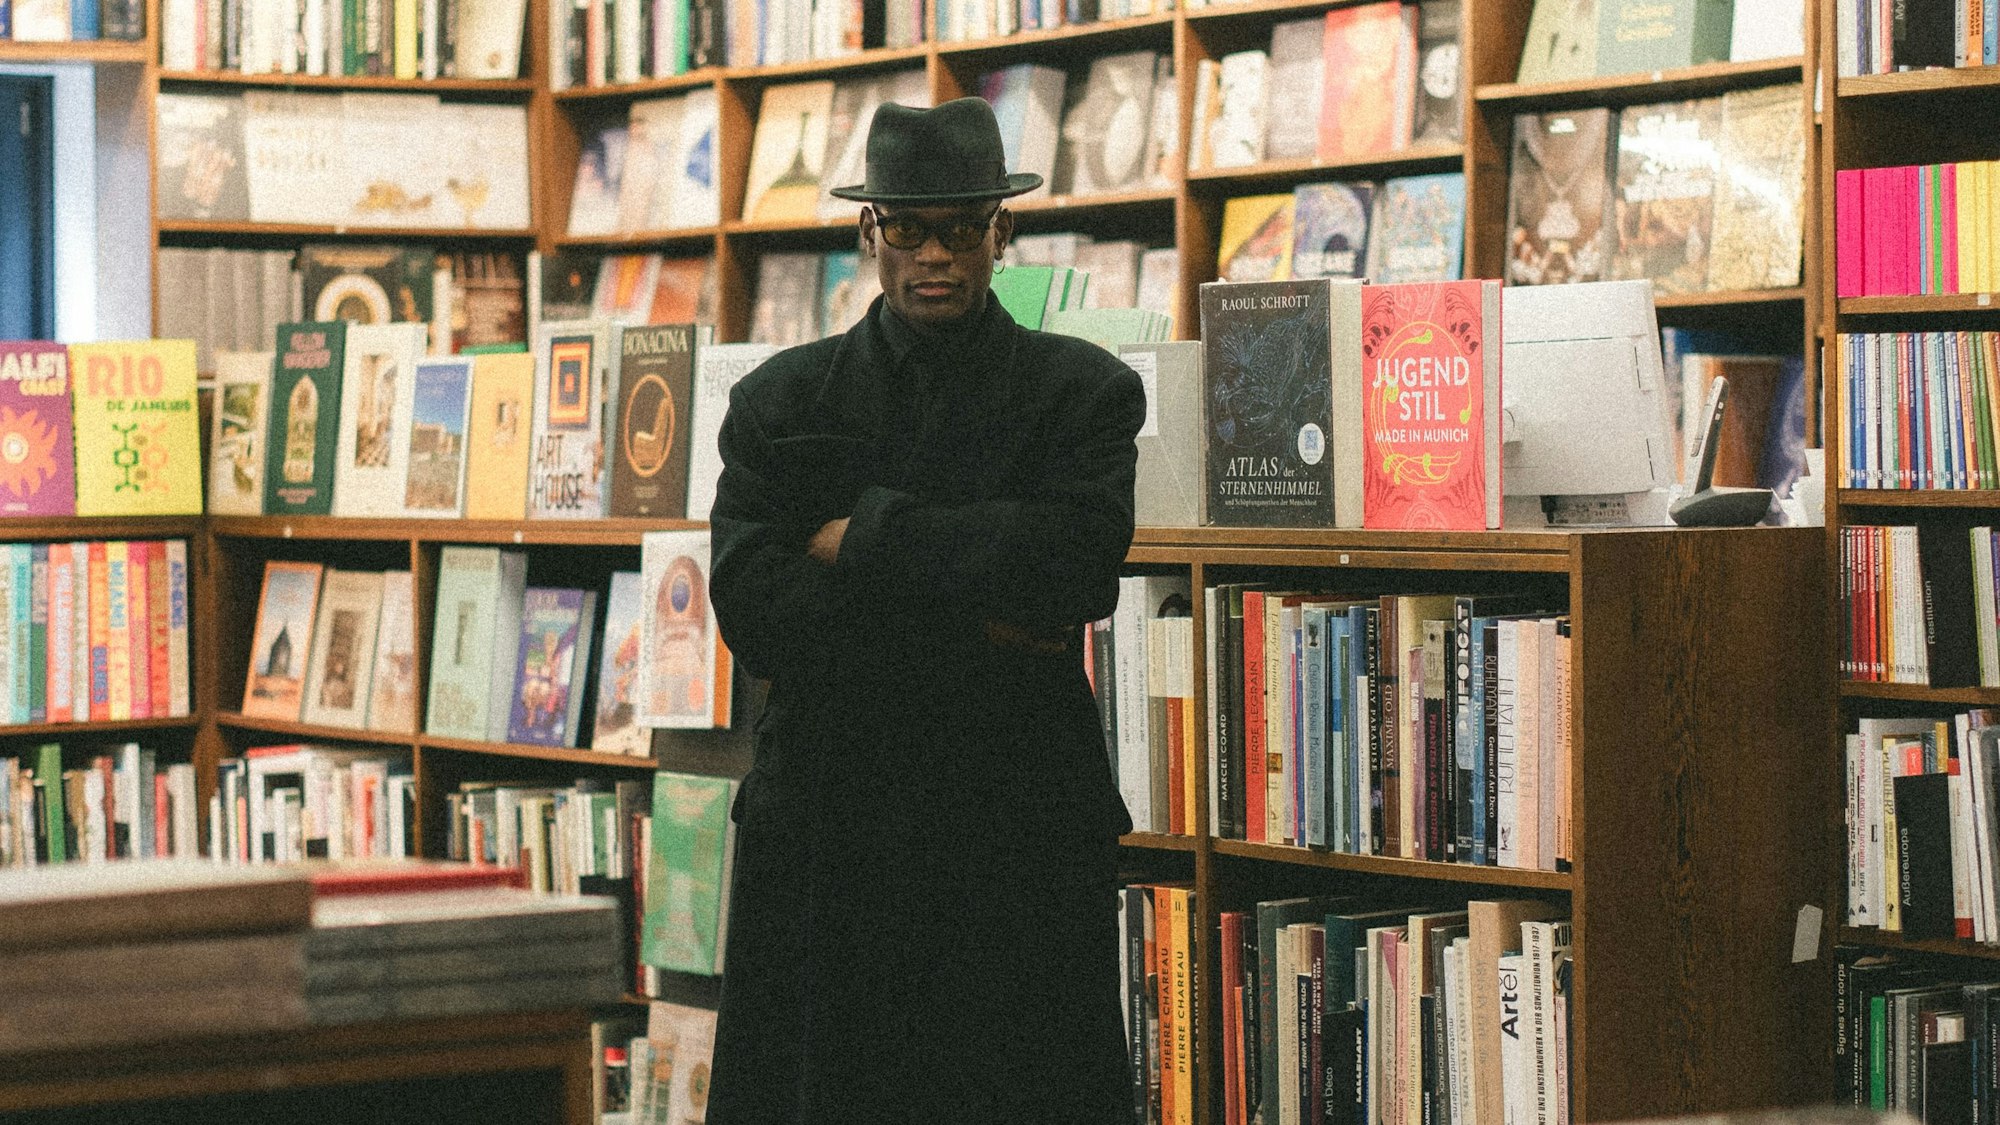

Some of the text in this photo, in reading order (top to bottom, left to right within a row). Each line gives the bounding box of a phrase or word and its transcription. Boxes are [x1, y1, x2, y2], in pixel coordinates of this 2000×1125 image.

[1222, 294, 1310, 312] RAOUL SCHROTT
[623, 328, 688, 356] BONACINA
[87, 354, 164, 397] RIO
[1373, 356, 1470, 387] JUGEND
[1399, 391, 1446, 421] STIL
[537, 434, 564, 467] ART
[1375, 427, 1469, 443] MADE IN MUNICH
[1226, 456, 1295, 477] ATLAS der
[534, 472, 584, 510] HOUSE
[1220, 481, 1322, 496] STERNENHIMMEL
[1925, 580, 1936, 644] Restitution
[1473, 642, 1482, 671] Paul
[1485, 654, 1498, 727] RUHLMANN
[1250, 660, 1260, 774] PIERRE LEGRAIN
[1384, 684, 1394, 768] MAXIME OLD
[1370, 710, 1378, 771] PARADISE
[1429, 714, 1438, 769] PIRANESI
[1488, 736, 1496, 766] Genius
[1430, 772, 1437, 788] AS
[1488, 768, 1496, 778] of
[1488, 780, 1496, 792] Art
[1902, 828, 1911, 907] Außereuropa
[1532, 926, 1540, 960] 1917-1937
[1533, 962, 1542, 1010] SOWJETUNION
[1161, 948, 1172, 1071] PIERRE CHAREAU
[1177, 950, 1186, 1074] PIERRE CHAREAU
[1301, 1009, 1306, 1020] DE
[1837, 963, 1846, 1055] Signes du corps
[1323, 1066, 1333, 1097] Déco
[1536, 1037, 1545, 1095] KUNSTHANDWERK
[1558, 1073, 1565, 1086] ON
